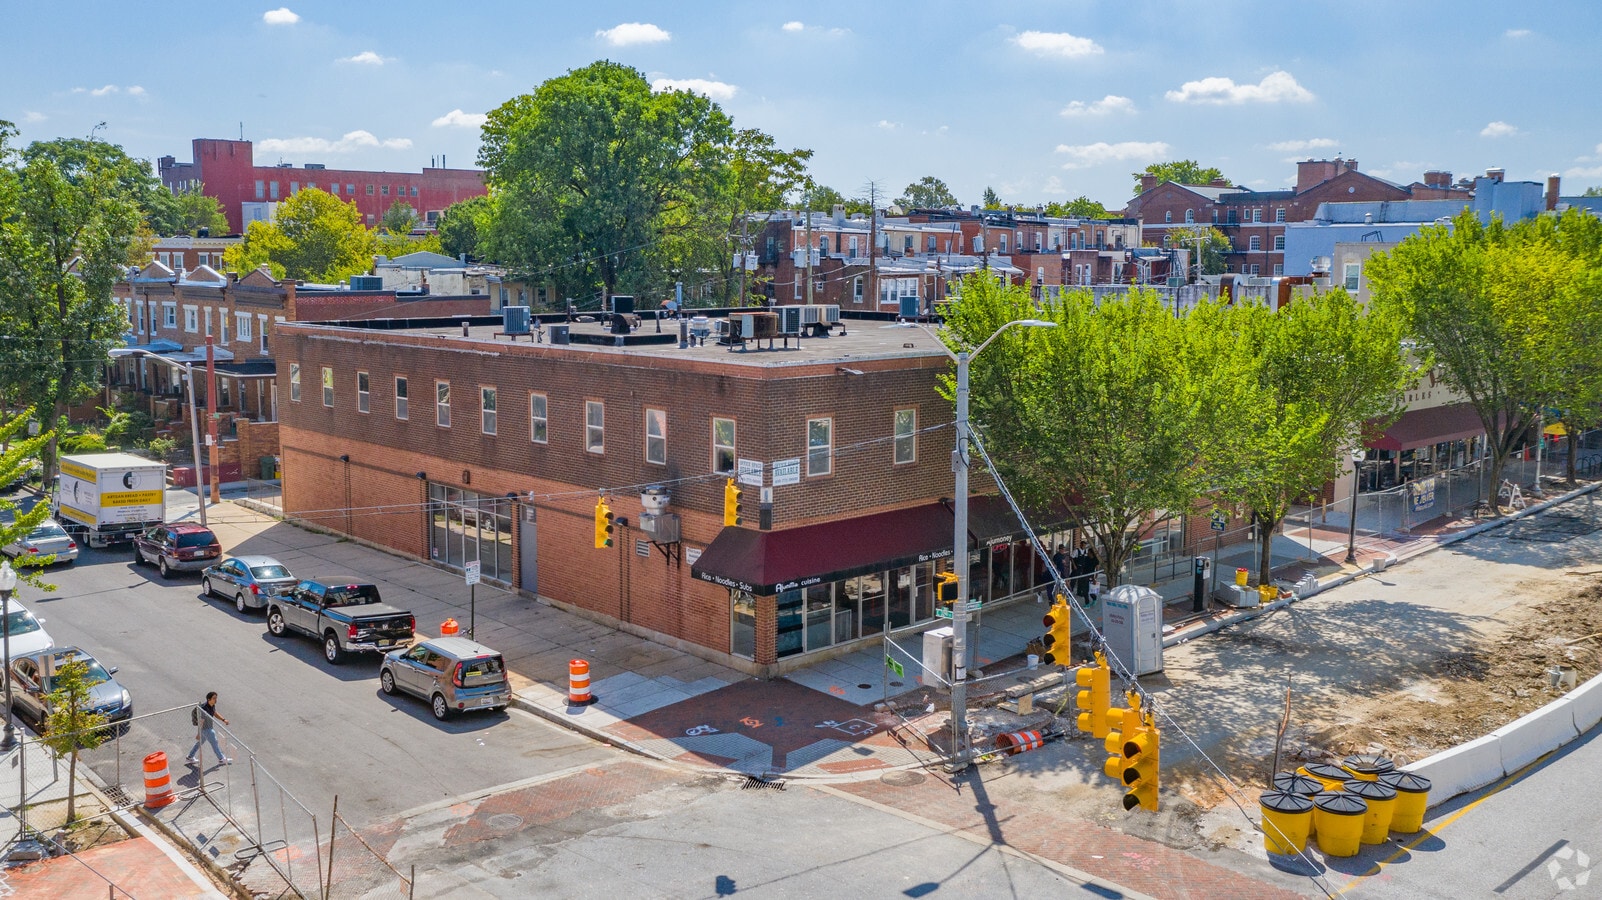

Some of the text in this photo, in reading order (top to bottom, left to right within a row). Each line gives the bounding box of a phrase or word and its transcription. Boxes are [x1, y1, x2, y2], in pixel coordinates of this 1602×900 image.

[932, 550, 950, 558] Noodles
[702, 572, 752, 592] Rice Noodles Subs
[801, 577, 820, 585] cuisine
